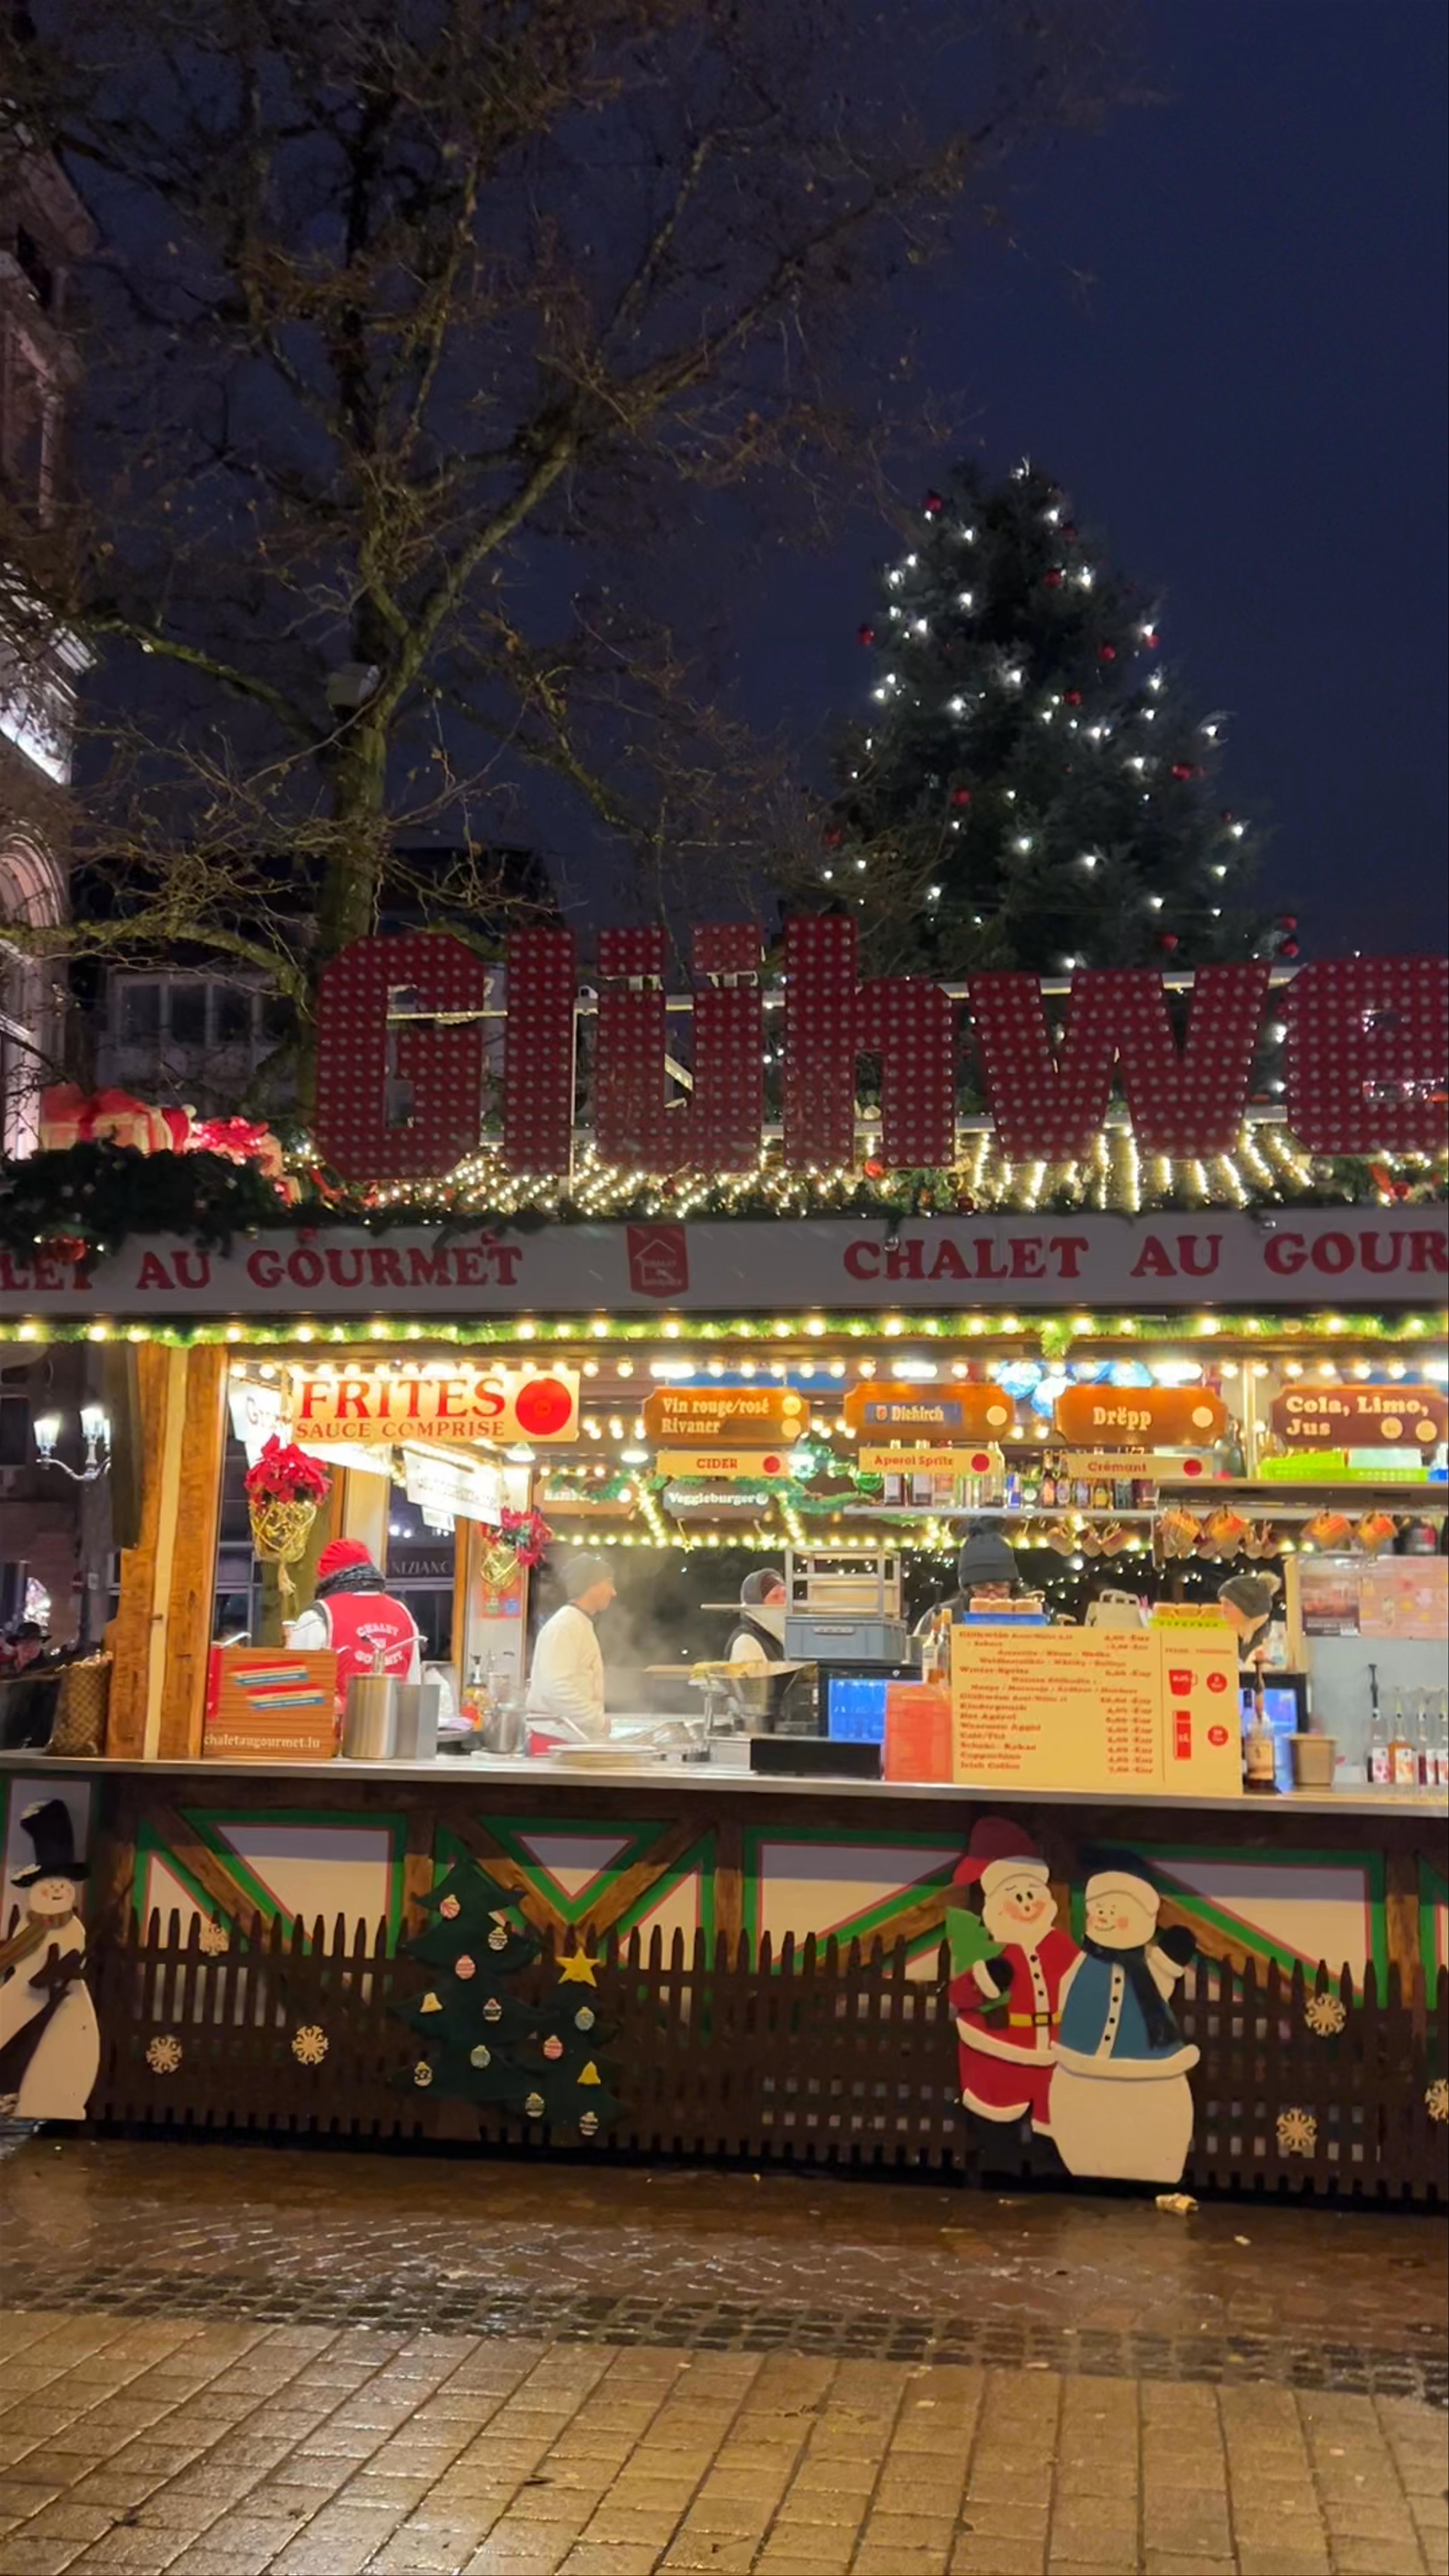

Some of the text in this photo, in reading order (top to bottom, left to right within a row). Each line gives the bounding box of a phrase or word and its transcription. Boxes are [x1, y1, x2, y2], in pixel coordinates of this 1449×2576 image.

[844, 1230, 1448, 1280] CHALET AU GOUR
[135, 1251, 211, 1289] AU
[247, 1245, 523, 1288] GOURMET
[299, 1378, 506, 1419] FRITES
[663, 1397, 688, 1413] Vin
[1286, 1396, 1429, 1417] Cola, Limo,
[296, 1421, 505, 1439] SAUCE COMPRISE
[661, 1418, 721, 1433] Rivaner
[1286, 1418, 1331, 1436] Jus
[697, 1458, 738, 1469] CIDER
[874, 1456, 953, 1467] Aperol Spritz
[668, 1492, 756, 1506] Veggieburger
[203, 1734, 321, 1749] chaletaugourmet.lu
